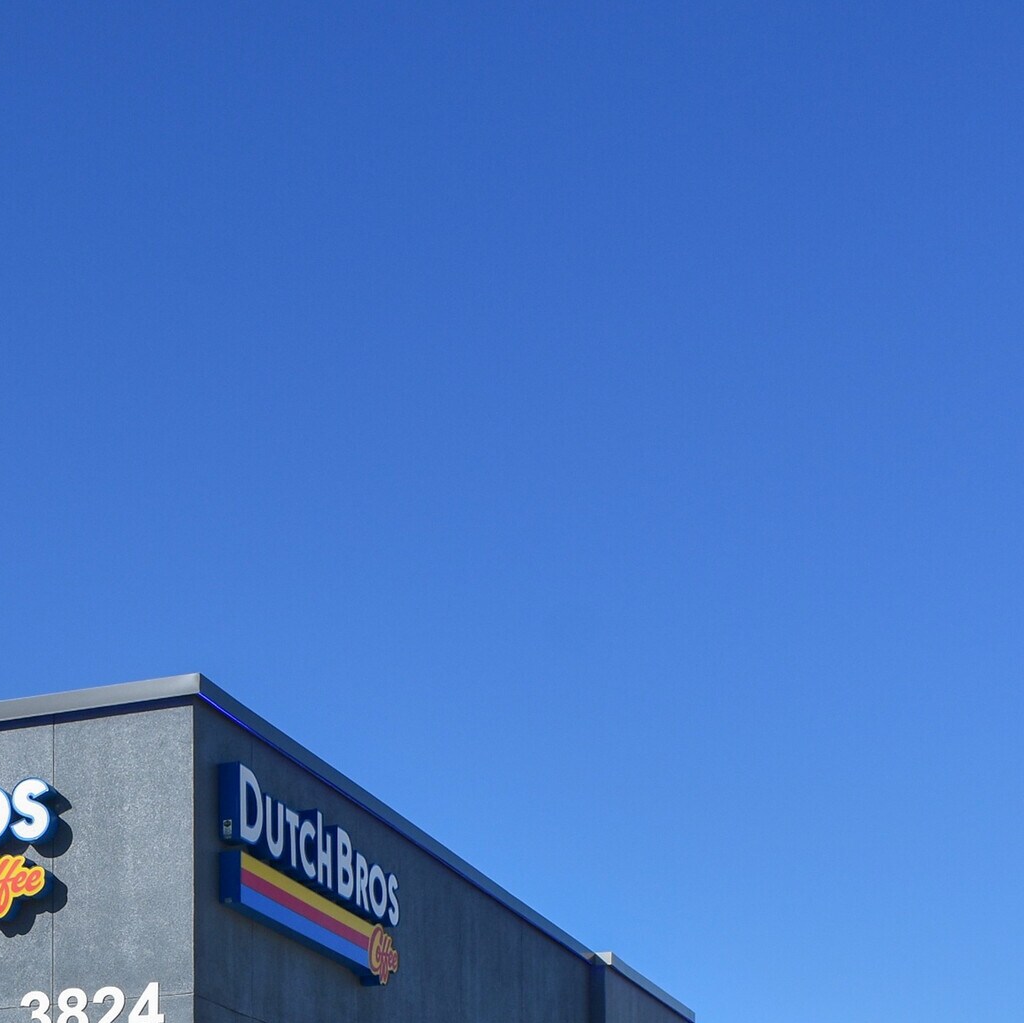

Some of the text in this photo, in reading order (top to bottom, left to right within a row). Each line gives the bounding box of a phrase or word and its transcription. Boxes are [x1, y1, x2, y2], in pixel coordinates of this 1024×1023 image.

[239, 763, 400, 927] DUTCH BROS
[369, 926, 398, 983] Coffee
